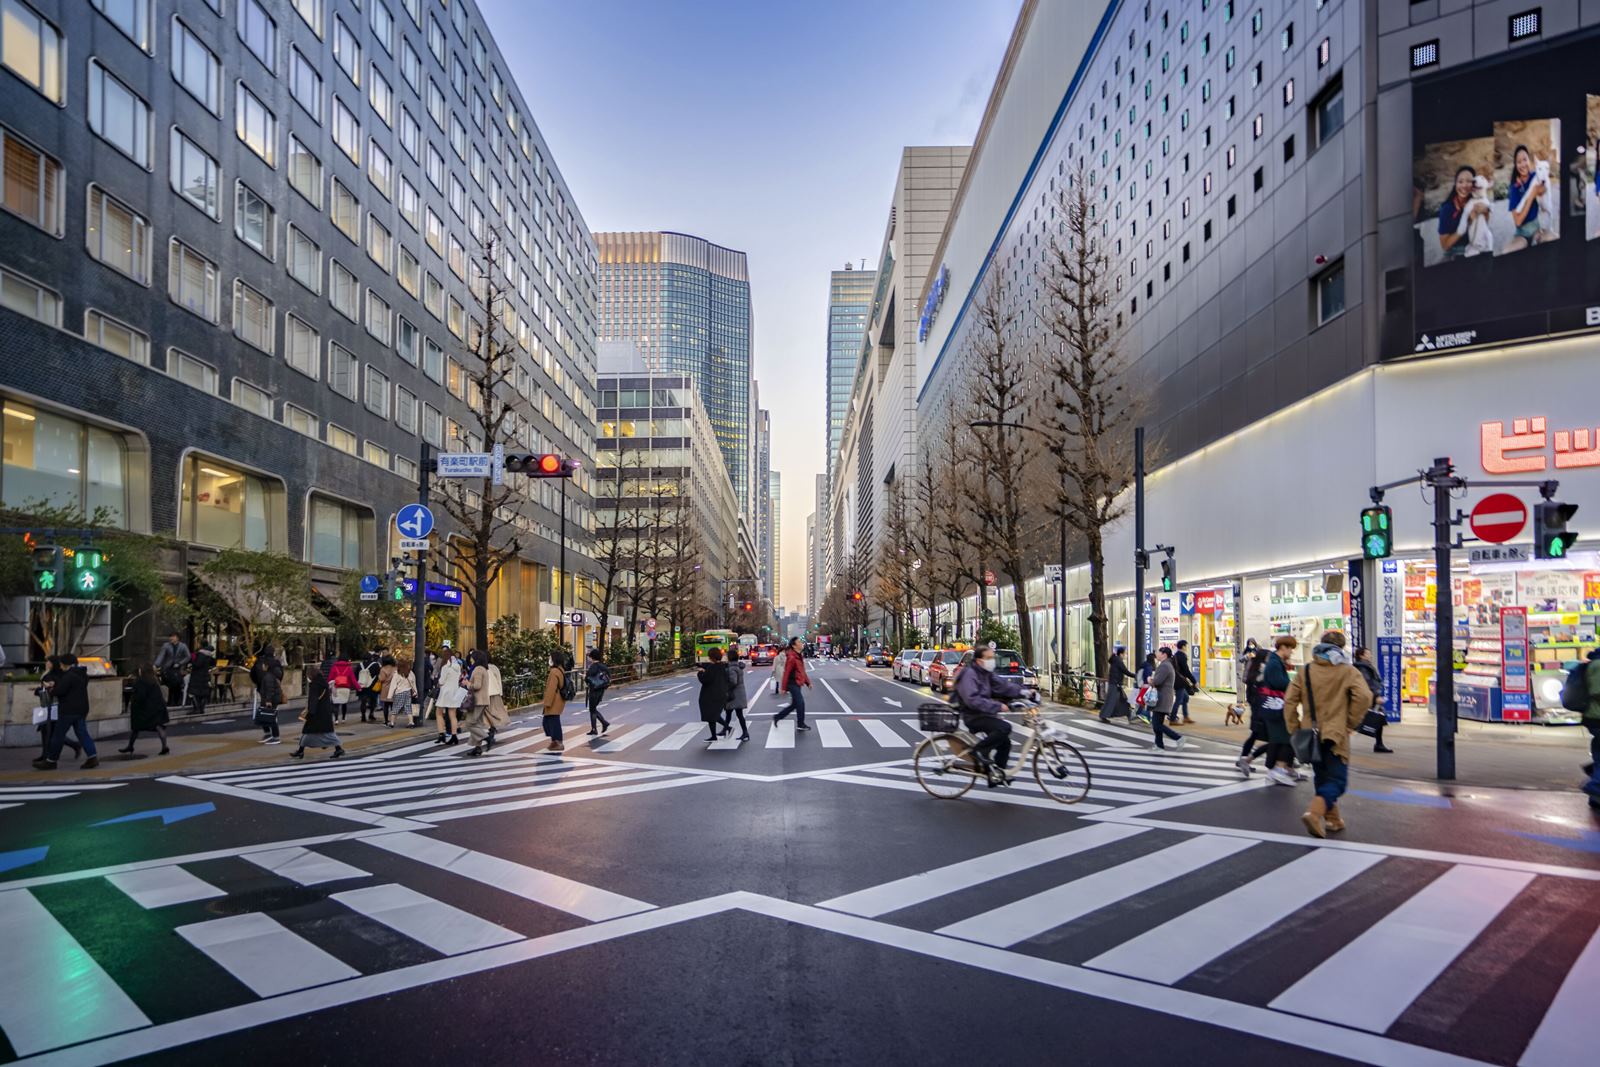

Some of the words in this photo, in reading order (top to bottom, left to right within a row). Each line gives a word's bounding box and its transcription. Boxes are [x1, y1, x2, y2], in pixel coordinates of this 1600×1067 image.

[1436, 331, 1476, 343] MITSUBISHI
[440, 456, 488, 466] 有楽町駅前
[1472, 547, 1526, 560] 自転車を除く
